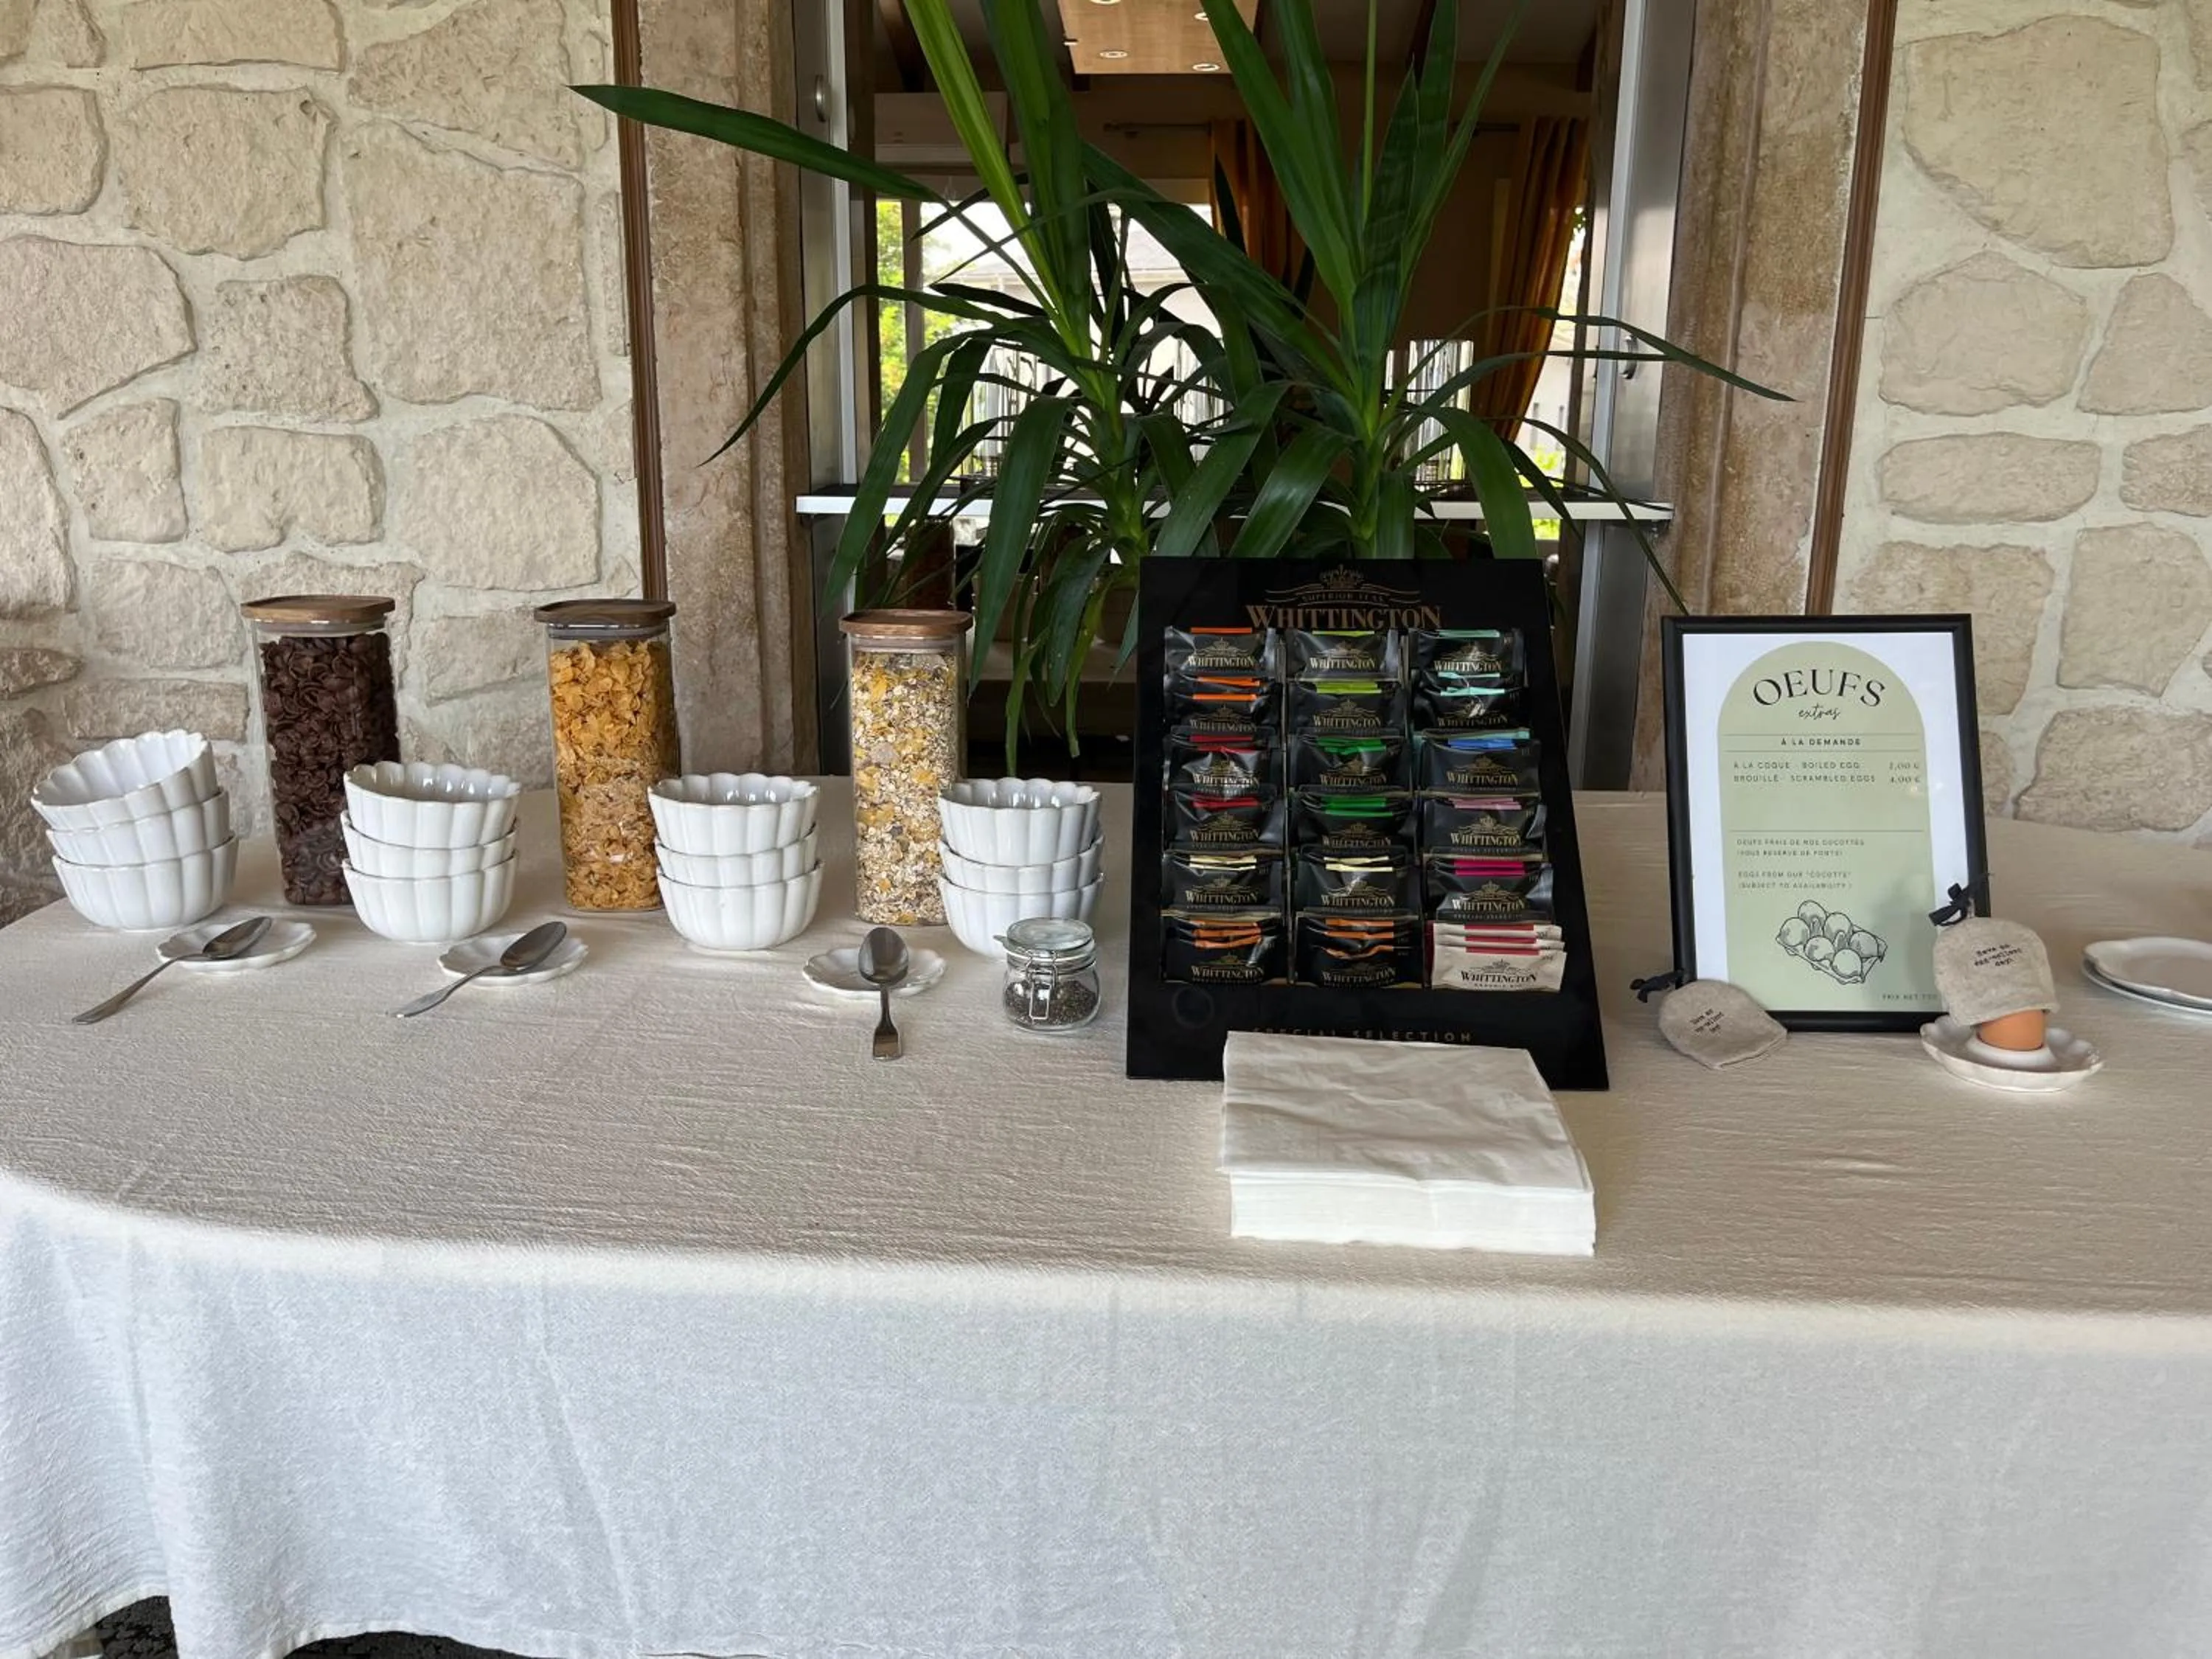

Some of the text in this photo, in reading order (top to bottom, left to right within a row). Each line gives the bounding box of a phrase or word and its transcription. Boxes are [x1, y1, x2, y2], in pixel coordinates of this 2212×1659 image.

[1245, 605, 1443, 629] WHITTINGTON
[1188, 655, 1256, 667] WHITTINGTON
[1310, 657, 1376, 669] WHITTINGTON
[1433, 660, 1503, 672] WHITTINGTON
[1752, 668, 1886, 708] OEUFS
[1798, 703, 1841, 720] extras
[1312, 714, 1382, 729] WHITTINGTON
[1446, 771, 1519, 785] WHITTINGTON
[1189, 828, 1260, 842] WHITTINGTON
[1450, 832, 1522, 846] WHITTINGTON
[1185, 889, 1259, 904] WHITTINGTON
[1321, 894, 1396, 907] WHITTINGTON
[1452, 898, 1526, 912] WHITTINGTON
[1191, 964, 1265, 979] WHITTINGTON
[1321, 966, 1397, 983] WHITTINGTON
[1460, 970, 1537, 983] WHITTINGTON
